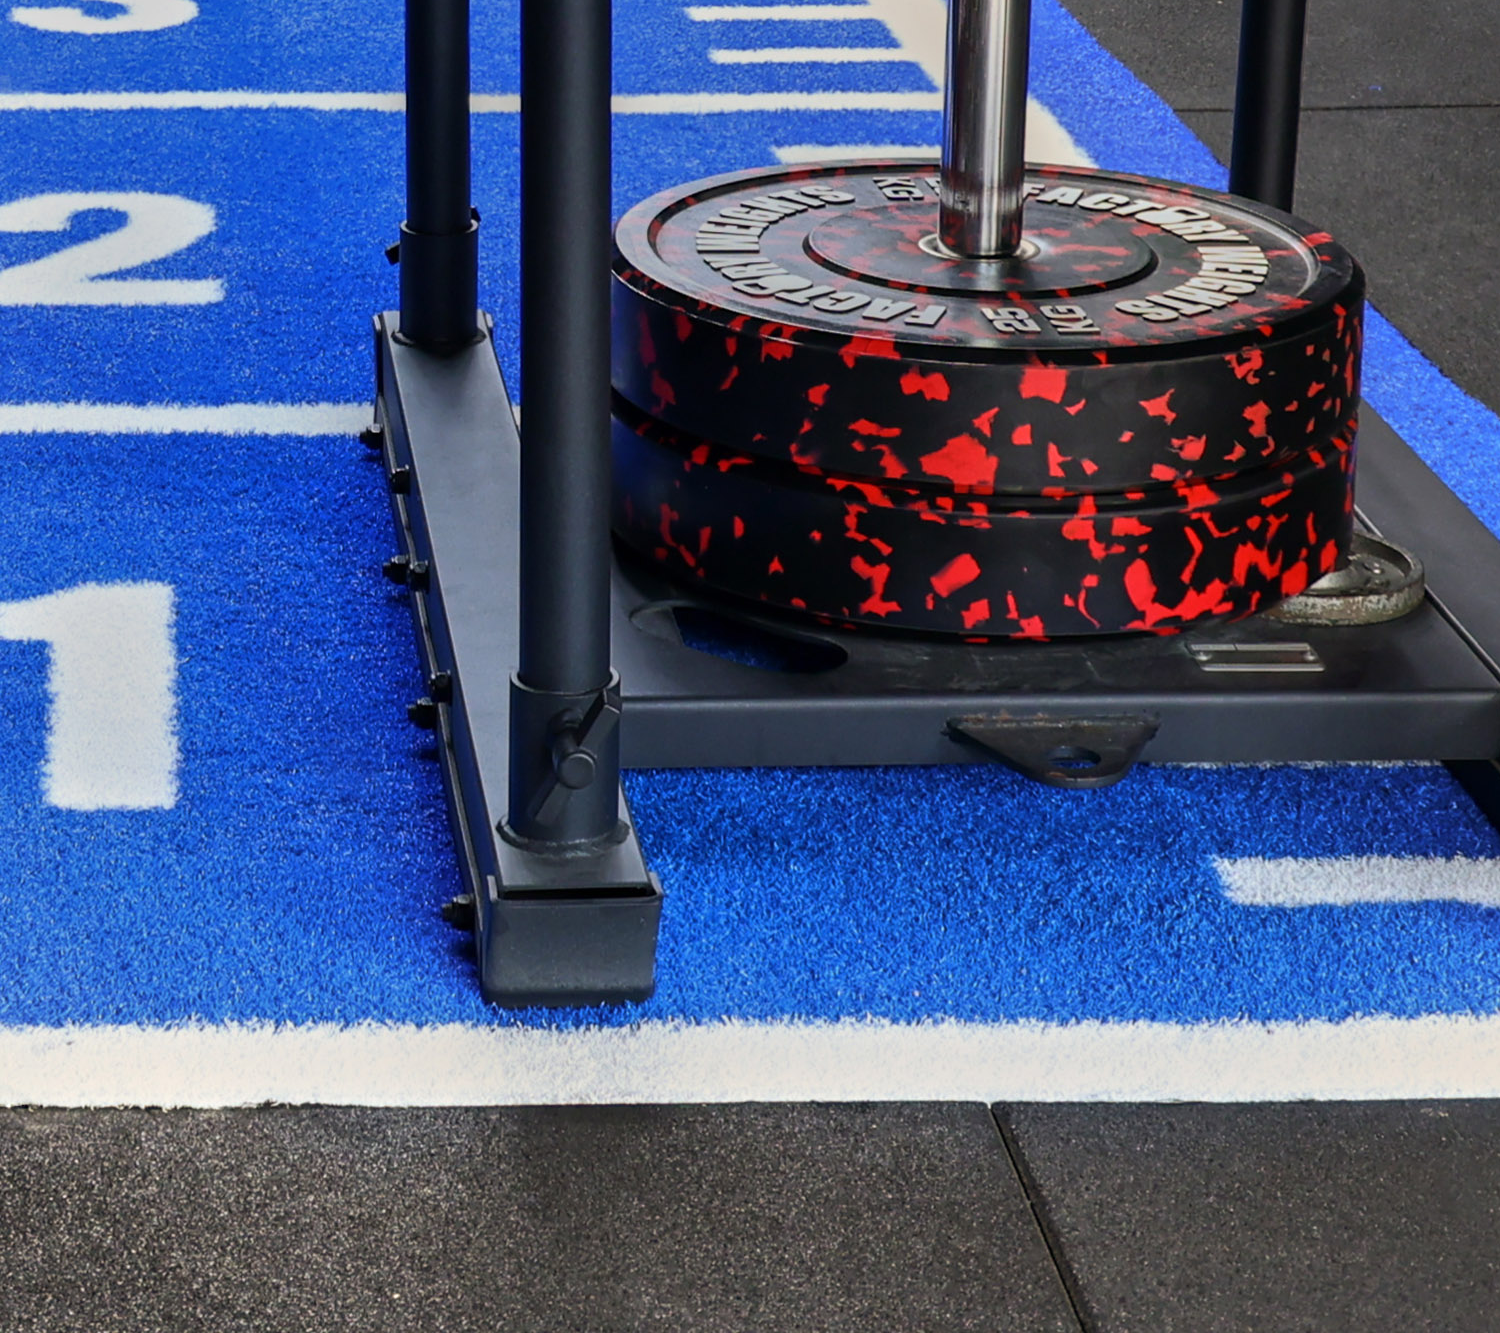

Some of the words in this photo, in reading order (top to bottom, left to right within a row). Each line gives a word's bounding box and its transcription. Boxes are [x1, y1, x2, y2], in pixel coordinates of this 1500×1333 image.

[695, 184, 856, 253] WEIGHTS
[872, 176, 924, 201] KG
[1023, 183, 1250, 243] FACTORY
[703, 256, 948, 327] FACTORY
[1115, 246, 1270, 322] WEIGHTS
[981, 307, 1041, 334] 25
[1040, 304, 1100, 335] KG
